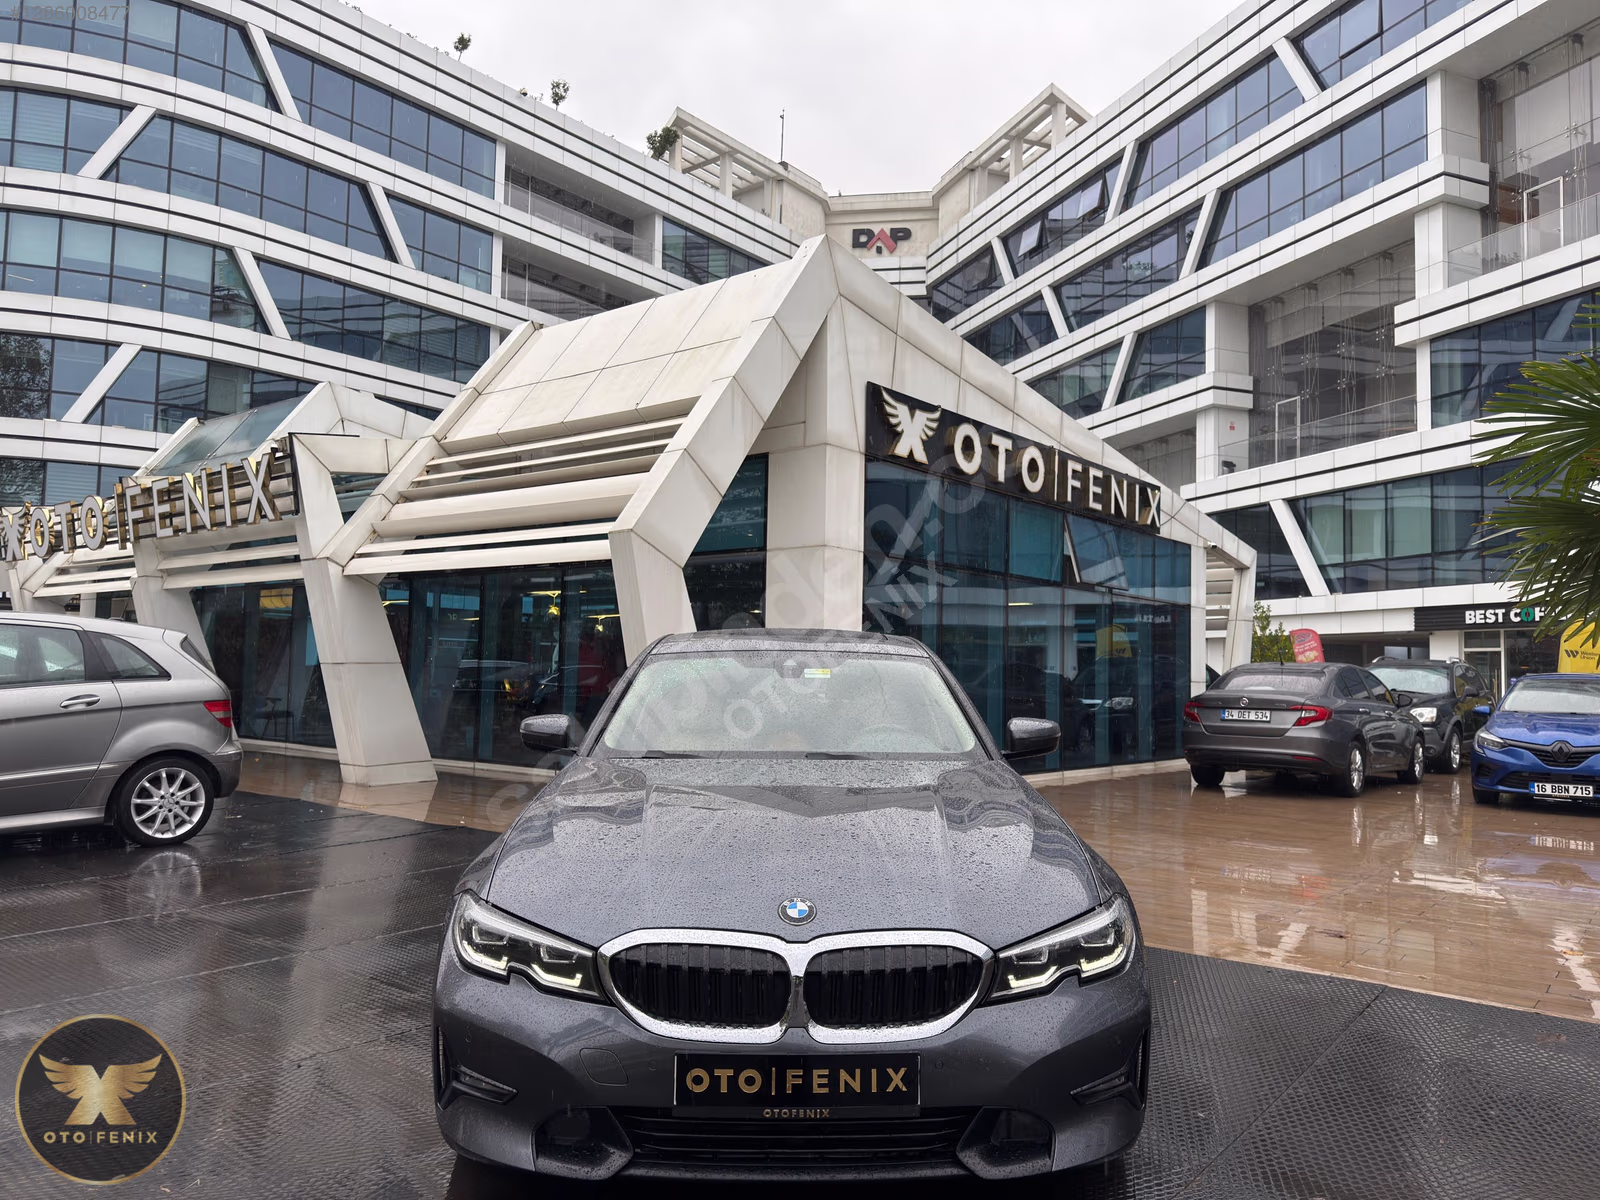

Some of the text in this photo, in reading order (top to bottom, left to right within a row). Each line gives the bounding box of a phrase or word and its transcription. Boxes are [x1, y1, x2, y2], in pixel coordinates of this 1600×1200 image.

[852, 227, 912, 254] DAP
[1465, 608, 1505, 624] BEST
[1225, 710, 1234, 718] 34
[1254, 711, 1269, 720] 534
[1536, 784, 1547, 793] 16
[1551, 785, 1570, 794] BBN
[1572, 786, 1591, 795] 715
[763, 1108, 830, 1118] OTOFENIX
